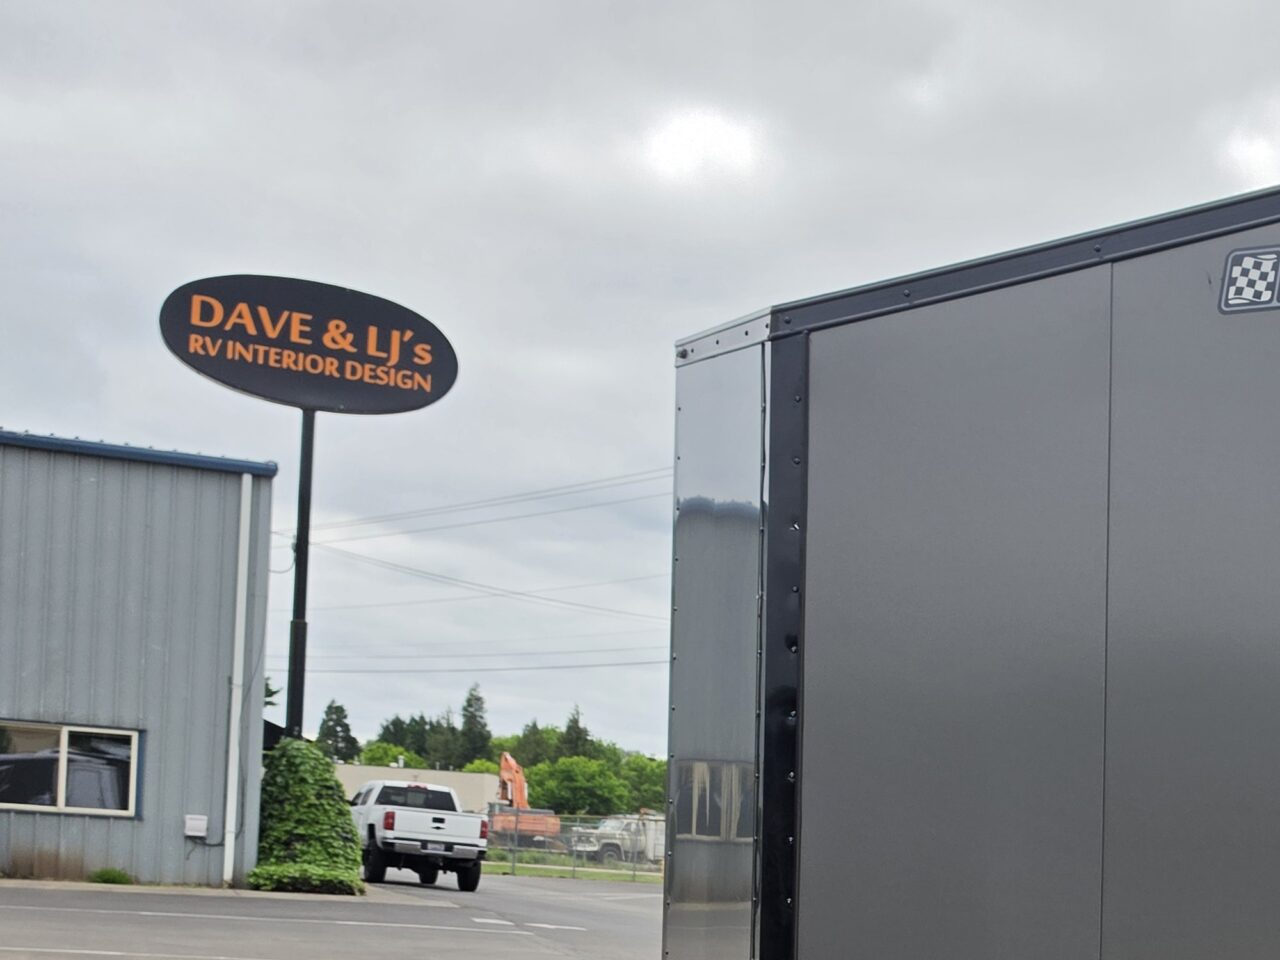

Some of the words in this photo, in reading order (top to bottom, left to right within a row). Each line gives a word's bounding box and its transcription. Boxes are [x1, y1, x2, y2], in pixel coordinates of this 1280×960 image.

[188, 333, 222, 357] RV
[226, 340, 341, 379] INTERIOR
[345, 360, 432, 393] DESIGN
[189, 294, 314, 346] DAVE
[321, 319, 358, 353] &
[366, 325, 434, 367] LJ's
